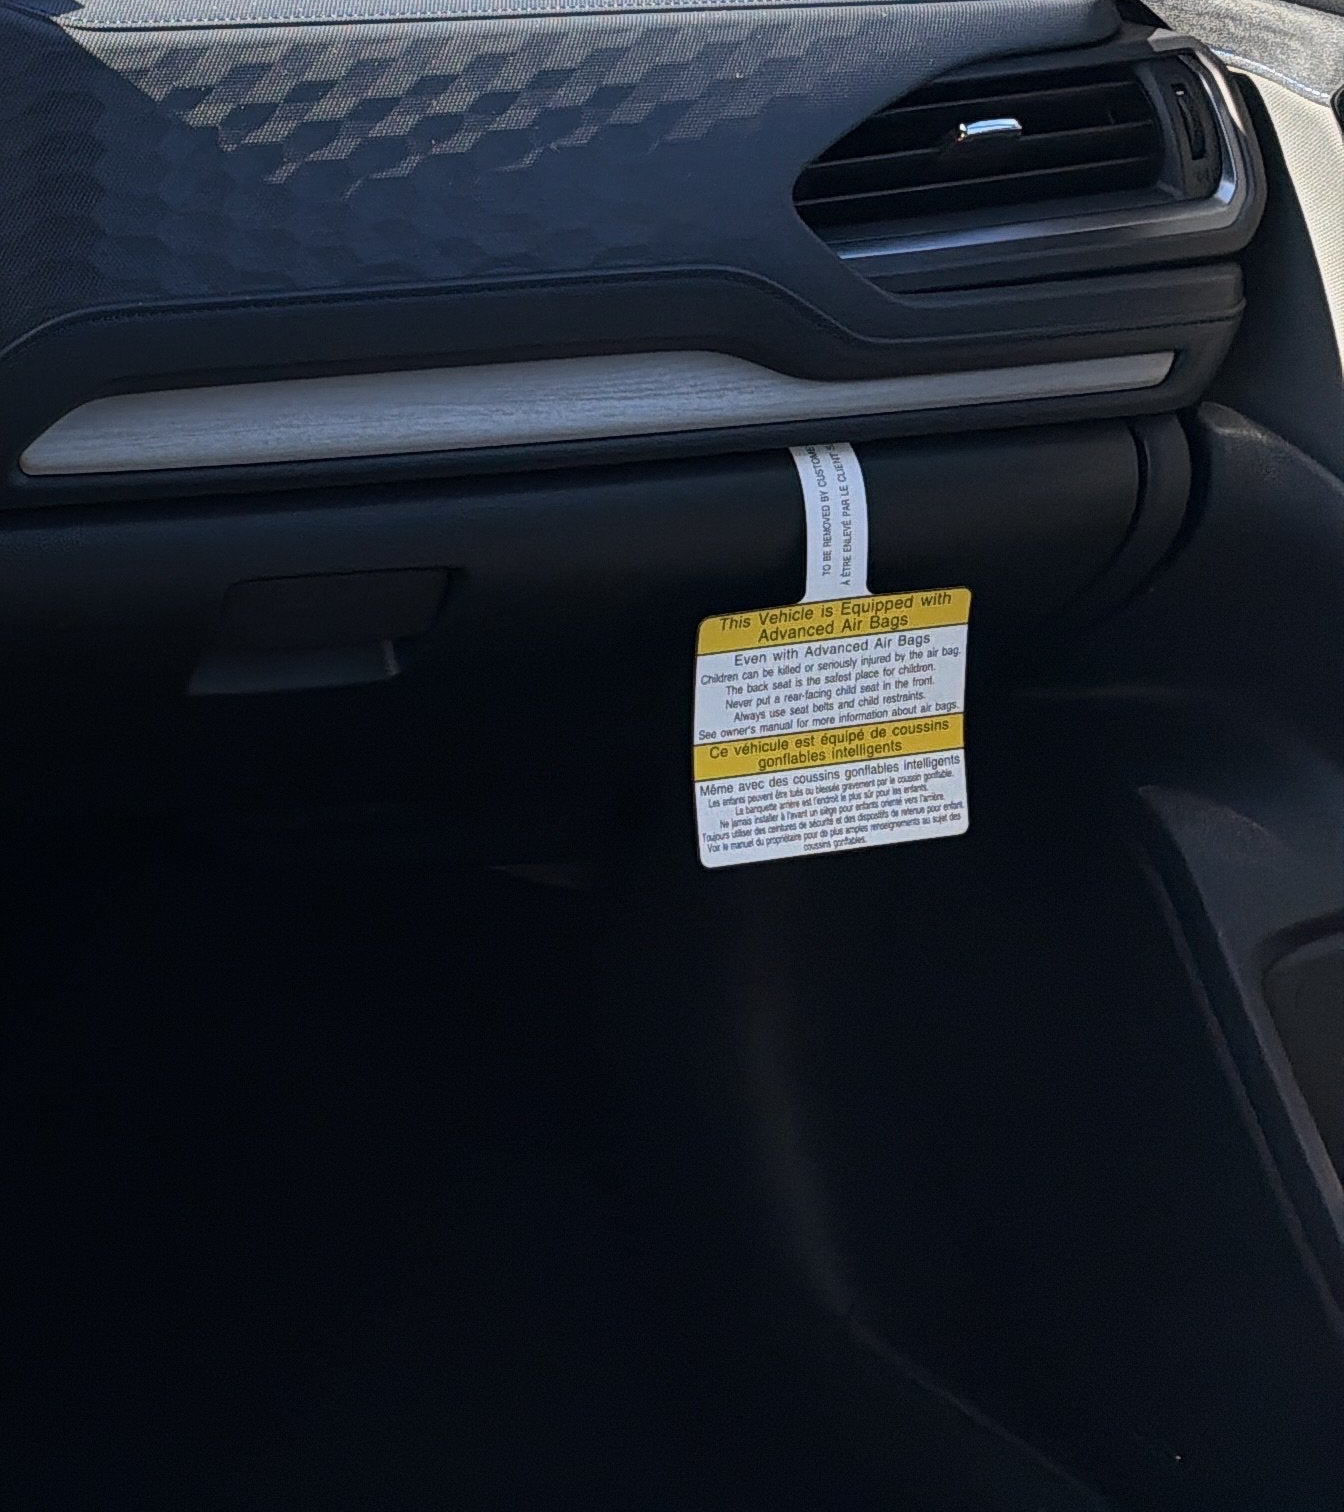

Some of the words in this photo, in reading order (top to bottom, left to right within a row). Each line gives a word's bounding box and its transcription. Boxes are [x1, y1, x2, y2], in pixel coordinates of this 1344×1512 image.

[829, 452, 847, 483] CLIENT
[819, 490, 830, 503] BY
[839, 484, 850, 498] LE
[842, 498, 852, 517] PAR
[821, 504, 832, 548] REMOVED
[822, 564, 831, 577] TO
[823, 550, 832, 562] BE
[720, 615, 751, 631] This
[758, 606, 814, 626] Vehicle
[820, 604, 834, 618] is
[840, 594, 914, 617] Equipped
[920, 591, 952, 607] with
[758, 620, 835, 644] Advanced
[841, 617, 863, 634] Air
[869, 614, 909, 631] Bags
[700, 672, 739, 686] Children
[741, 670, 759, 681] can
[762, 667, 774, 678] be
[777, 663, 802, 675] killed
[804, 663, 815, 673] or
[860, 652, 892, 667] injured
[894, 651, 906, 663] by
[909, 649, 924, 660] the
[926, 647, 939, 658] air
[941, 646, 961, 658] bag.
[734, 653, 767, 667] Even
[772, 649, 799, 662] with
[804, 639, 869, 658] Advanced
[874, 637, 893, 649] Air
[897, 633, 931, 648] Bags
[725, 685, 743, 696] The
[746, 681, 769, 694] back
[772, 678, 792, 690] seat
[795, 677, 804, 688] is
[806, 675, 821, 686] the
[855, 669, 880, 683] place
[882, 666, 895, 677] for
[725, 698, 754, 710] Never
[756, 695, 771, 709] put
[774, 695, 781, 704] a
[784, 688, 833, 703] rear-facing
[835, 684, 857, 697] child
[859, 681, 880, 693] seat
[882, 680, 892, 691] in
[894, 678, 909, 689] the
[698, 729, 717, 741] See
[720, 723, 756, 737] owner's
[759, 719, 794, 733] manual
[796, 717, 810, 729] for
[812, 715, 836, 727] more
[838, 707, 889, 723] information
[891, 704, 918, 717] about
[920, 702, 933, 712] air
[935, 700, 959, 713] bags.
[733, 710, 766, 723] Always
[769, 708, 786, 718] use
[789, 704, 810, 715] seat
[837, 698, 855, 710] and
[857, 695, 880, 707] child
[882, 690, 926, 705] restraints.
[709, 746, 729, 760] Ce
[733, 738, 790, 756] véhicule
[794, 734, 815, 749] est
[820, 729, 865, 747] équipé
[870, 726, 887, 740] de
[891, 719, 950, 737] coussins
[758, 748, 826, 772] gonflables
[831, 739, 903, 760] intelligents
[738, 780, 765, 793] avec
[768, 776, 789, 788] des
[792, 769, 841, 785] coussins
[844, 762, 900, 781] gonflables
[903, 754, 961, 771] intelligents
